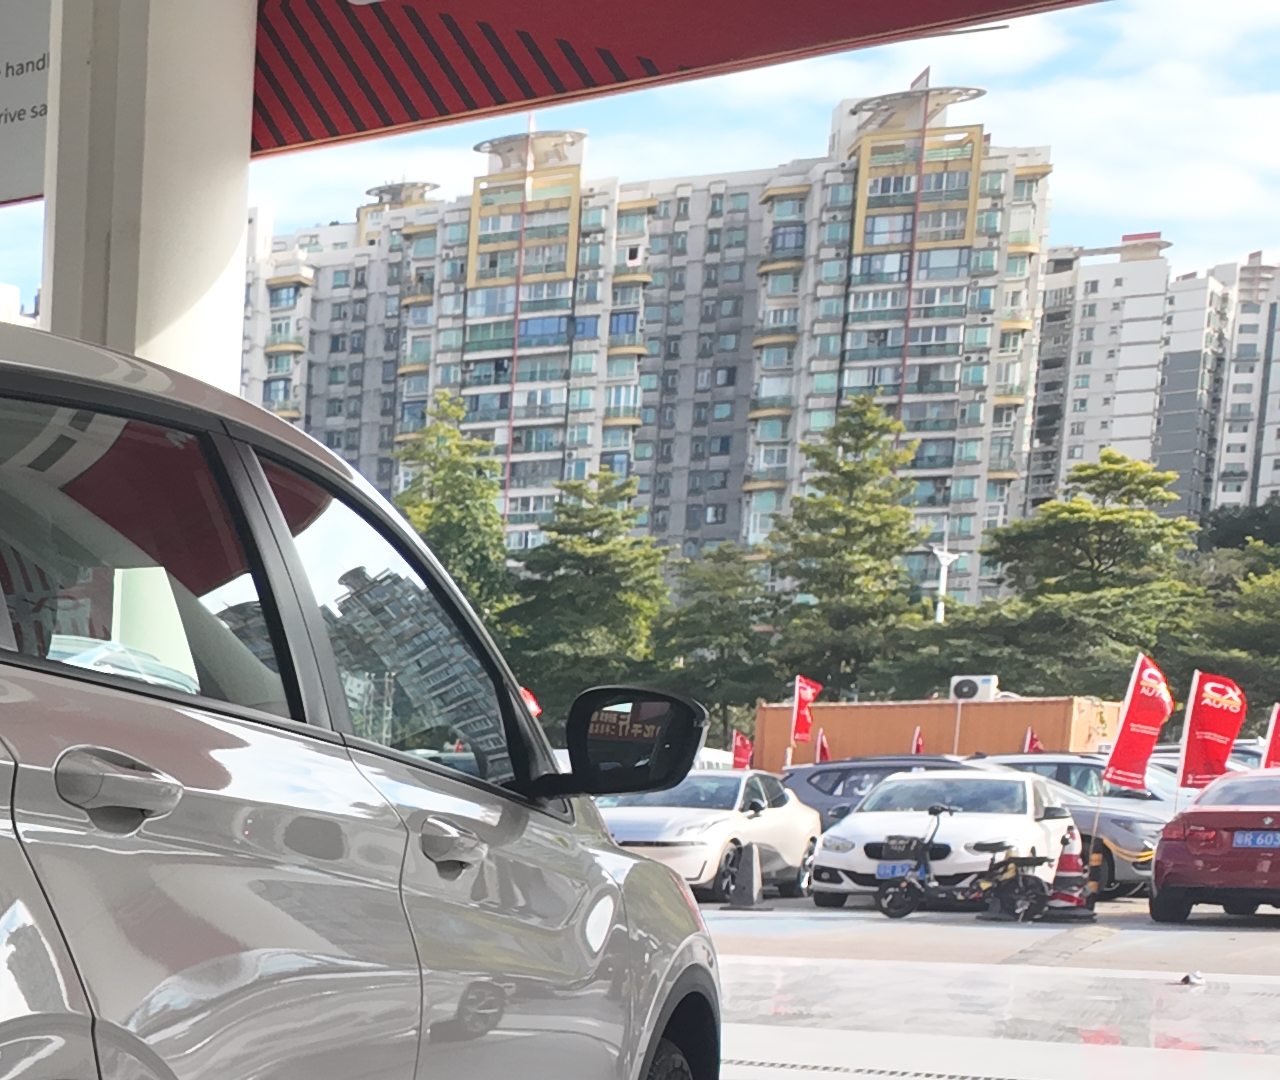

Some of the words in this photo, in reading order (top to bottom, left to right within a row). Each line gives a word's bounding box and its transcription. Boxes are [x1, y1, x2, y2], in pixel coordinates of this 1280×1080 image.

[30, 103, 48, 119] sa
[1203, 682, 1241, 703] CX
[1201, 698, 1241, 713] AUTO
